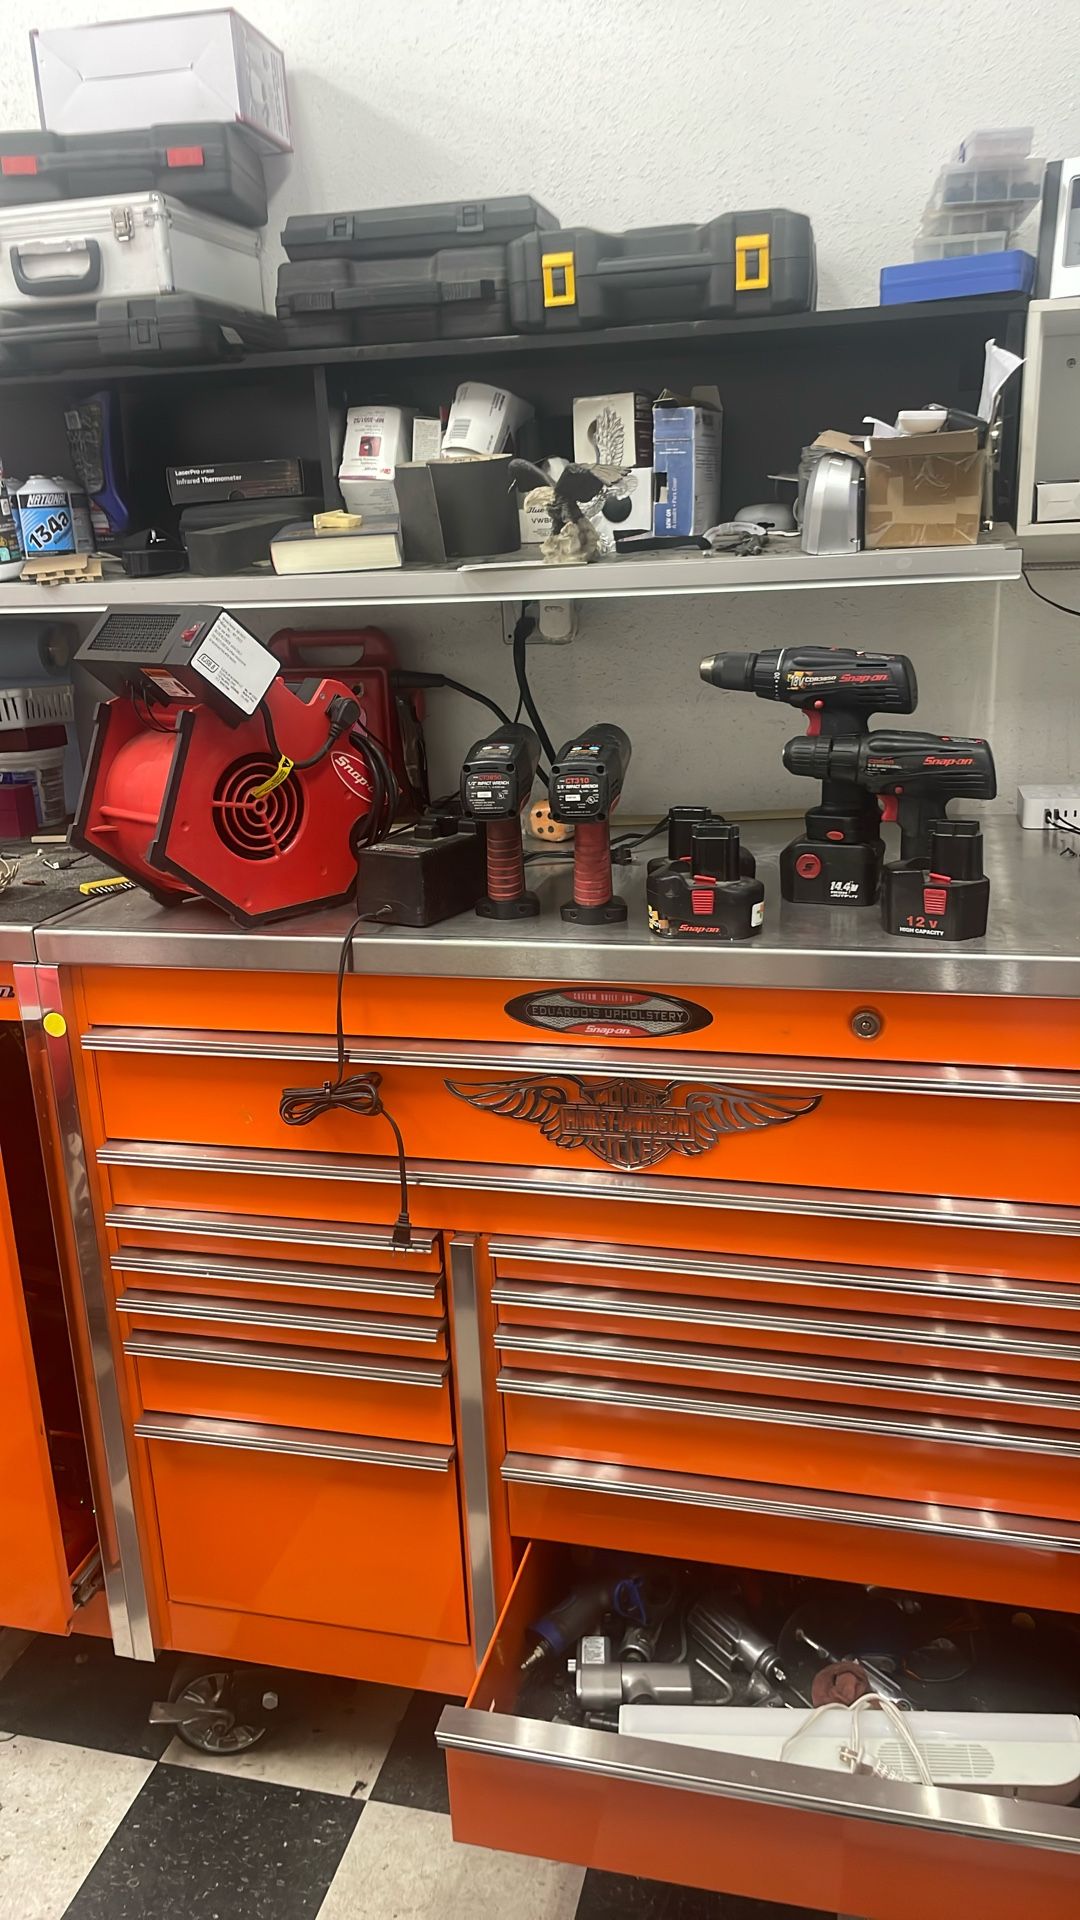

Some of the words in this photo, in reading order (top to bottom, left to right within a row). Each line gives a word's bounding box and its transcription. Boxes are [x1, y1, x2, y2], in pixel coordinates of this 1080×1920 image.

[175, 468, 200, 476] LaserPro
[176, 477, 200, 485] Infrared
[201, 475, 241, 483] Thermometer
[29, 512, 69, 549] 134a
[839, 673, 889, 683] Snap-on
[923, 756, 973, 767] Snap-on
[907, 915, 925, 928] 12
[679, 924, 720, 934] Snap-on
[915, 928, 944, 937] CAPACITY
[573, 992, 597, 1001] CUSTOM
[601, 993, 618, 1002] BUILT
[532, 1006, 600, 1018] EDUARDO'S
[604, 1008, 684, 1022] UPHOLSTERY
[585, 1025, 631, 1035] Snap-on
